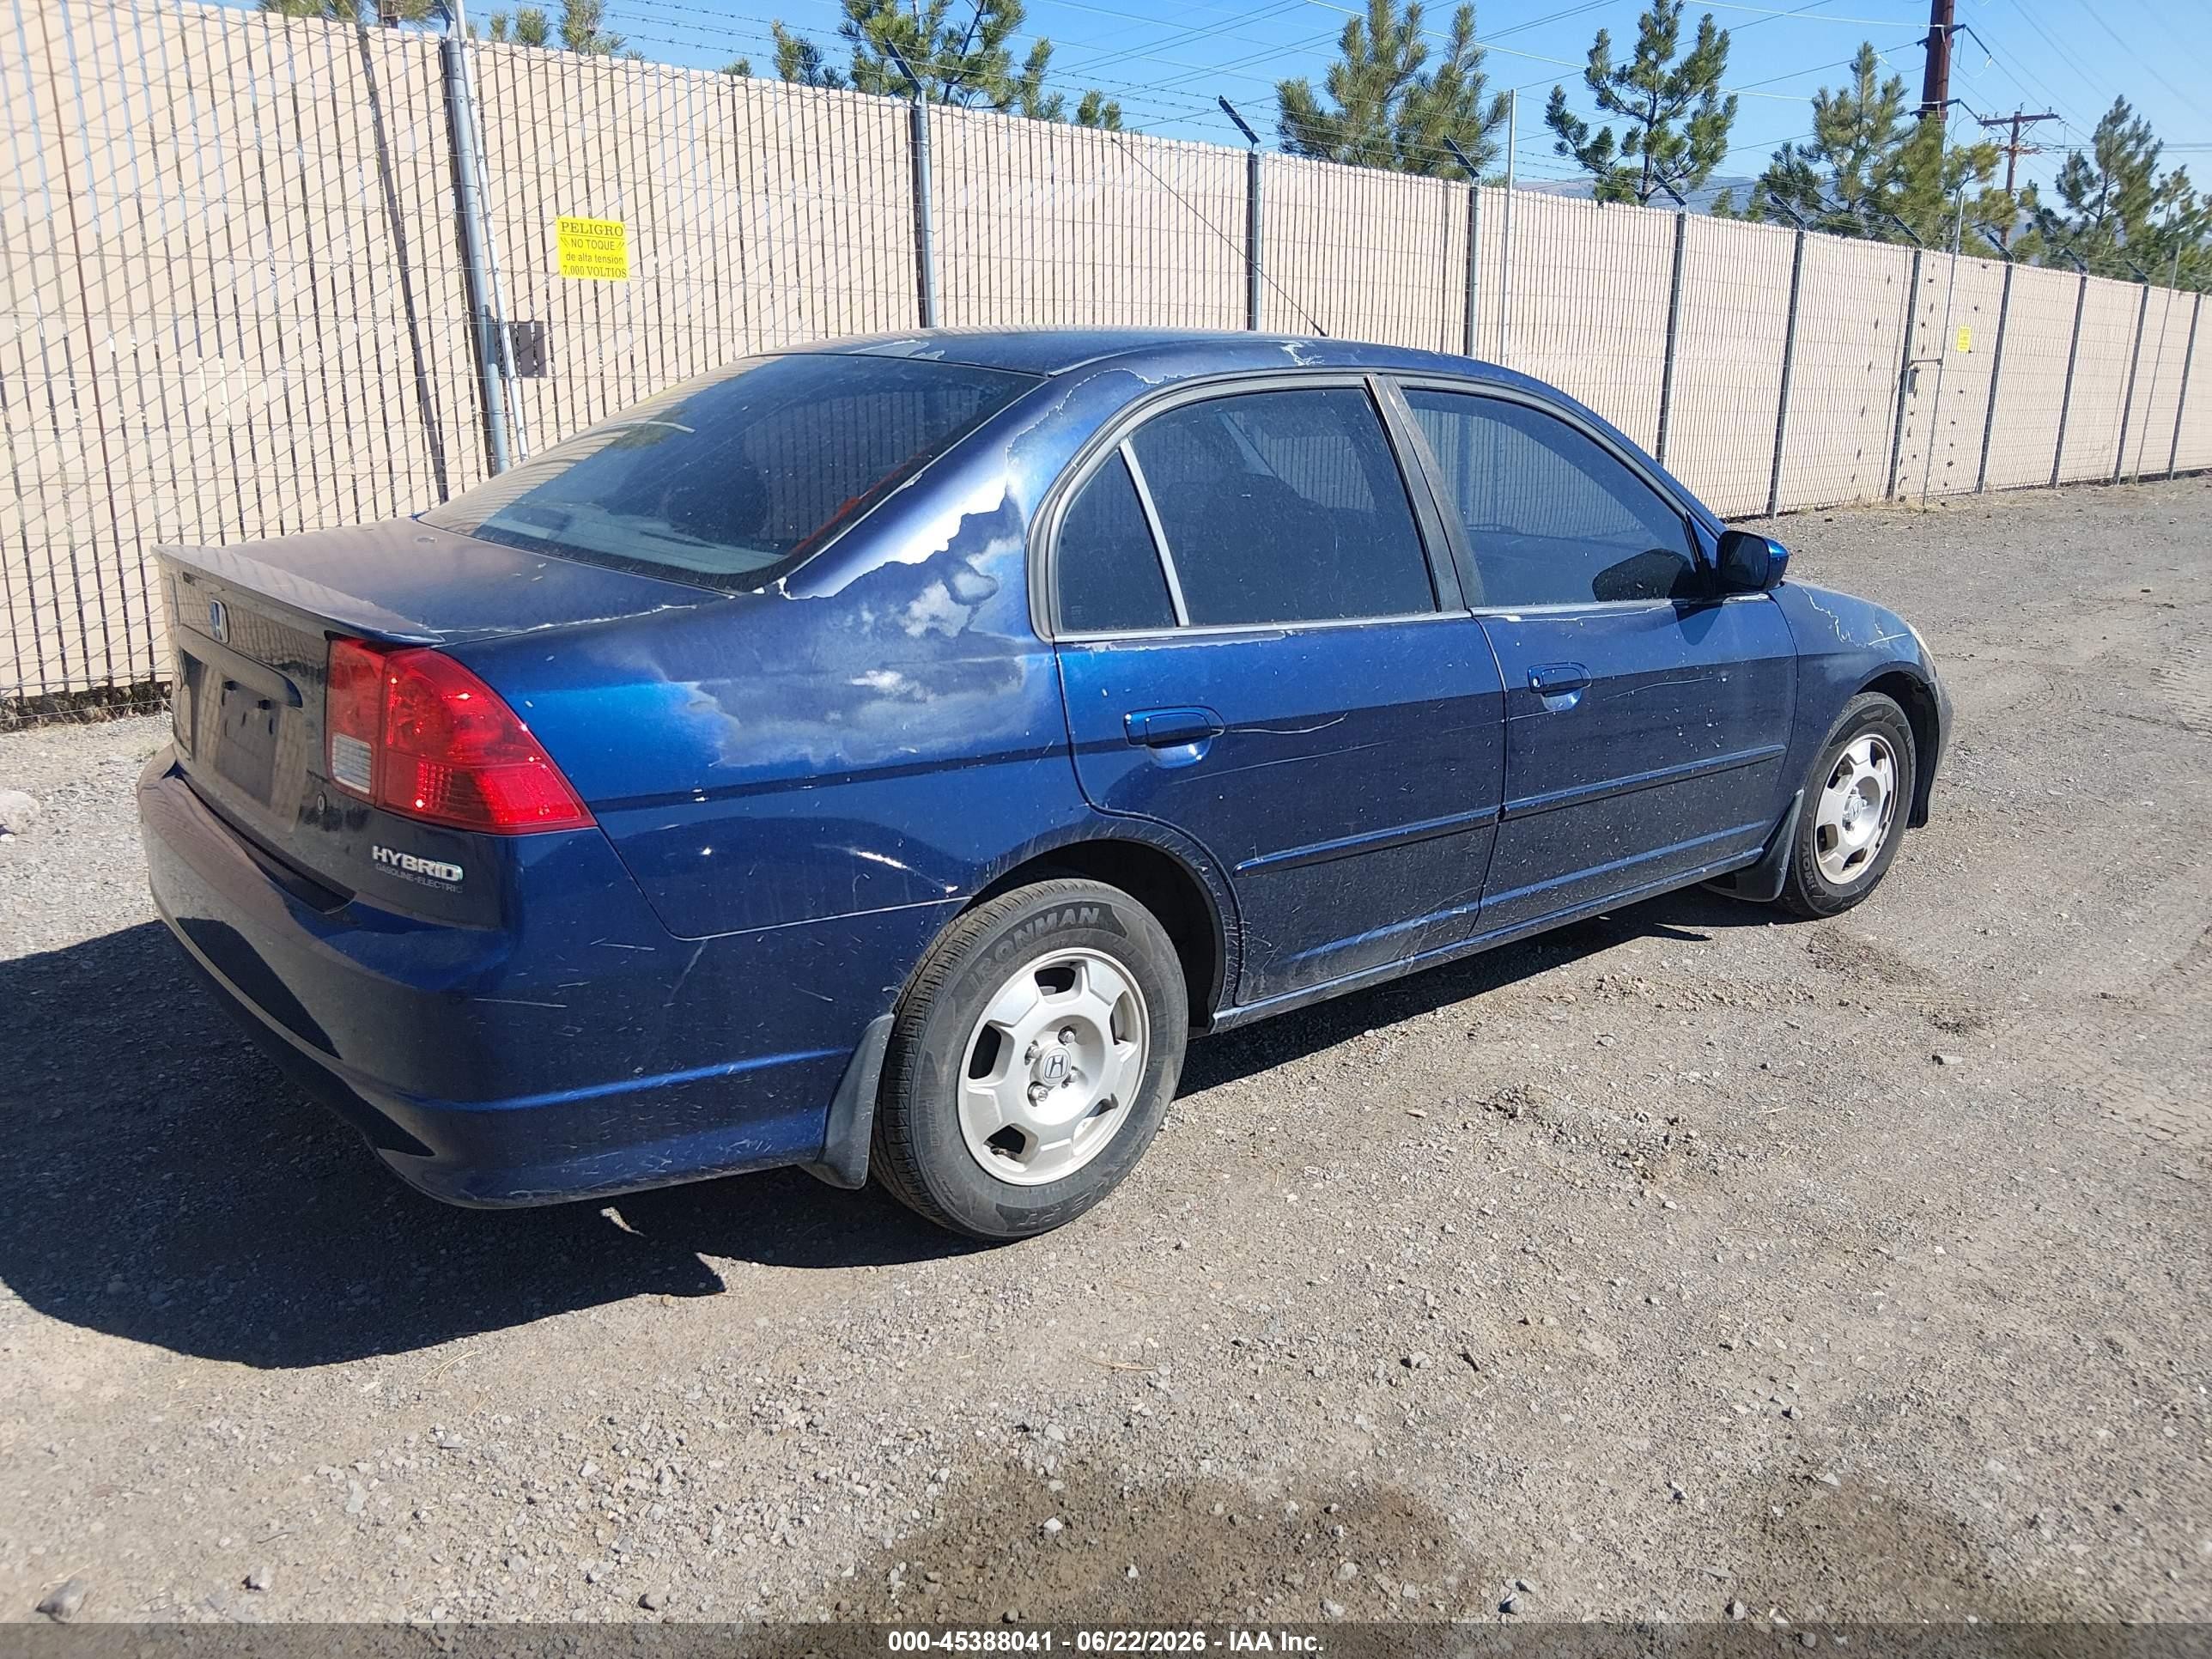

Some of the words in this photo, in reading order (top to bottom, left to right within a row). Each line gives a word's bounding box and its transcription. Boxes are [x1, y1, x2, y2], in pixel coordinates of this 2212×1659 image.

[562, 222, 623, 237] PELIGRO
[571, 238, 584, 248] NO
[585, 240, 616, 251] TOQUE
[566, 252, 576, 261] de
[578, 252, 592, 263] alta
[594, 254, 624, 264] tension
[586, 266, 627, 278] VOLTIOS
[372, 845, 464, 881] HYBRID
[376, 863, 464, 894] GASOLINE-ELECTRIC
[968, 906, 1100, 988] IRONMAN
